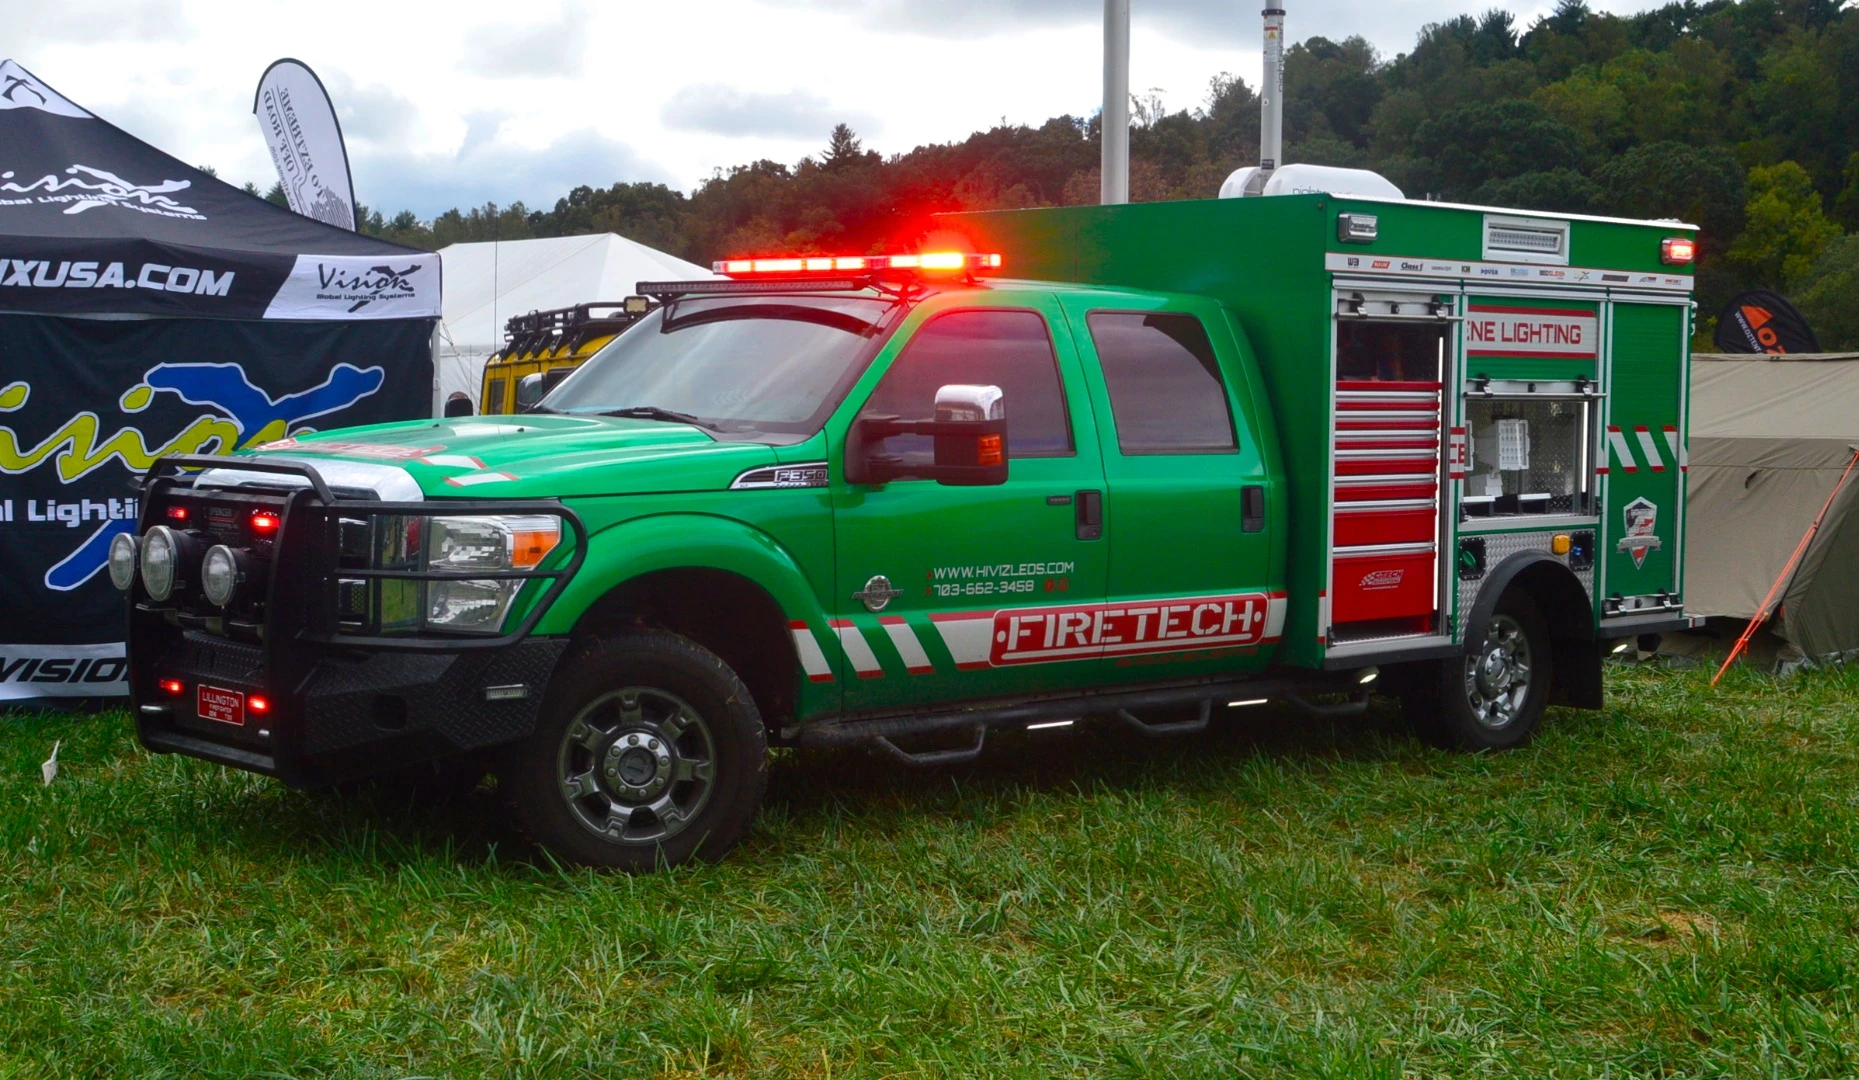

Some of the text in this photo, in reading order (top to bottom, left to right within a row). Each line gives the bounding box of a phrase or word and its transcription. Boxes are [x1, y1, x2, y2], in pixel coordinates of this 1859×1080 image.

[318, 263, 414, 292] Vision
[344, 293, 376, 301] Lighting
[1501, 322, 1581, 345] LIGHTING
[774, 465, 829, 483] F350
[934, 562, 1074, 579] WWW.HIVIZLEDS.COM
[934, 580, 1035, 597] 703-662-3458
[1007, 600, 1254, 651] FIRETECH
[0, 657, 128, 683] VISIO
[202, 692, 239, 708] LILLINGTON
